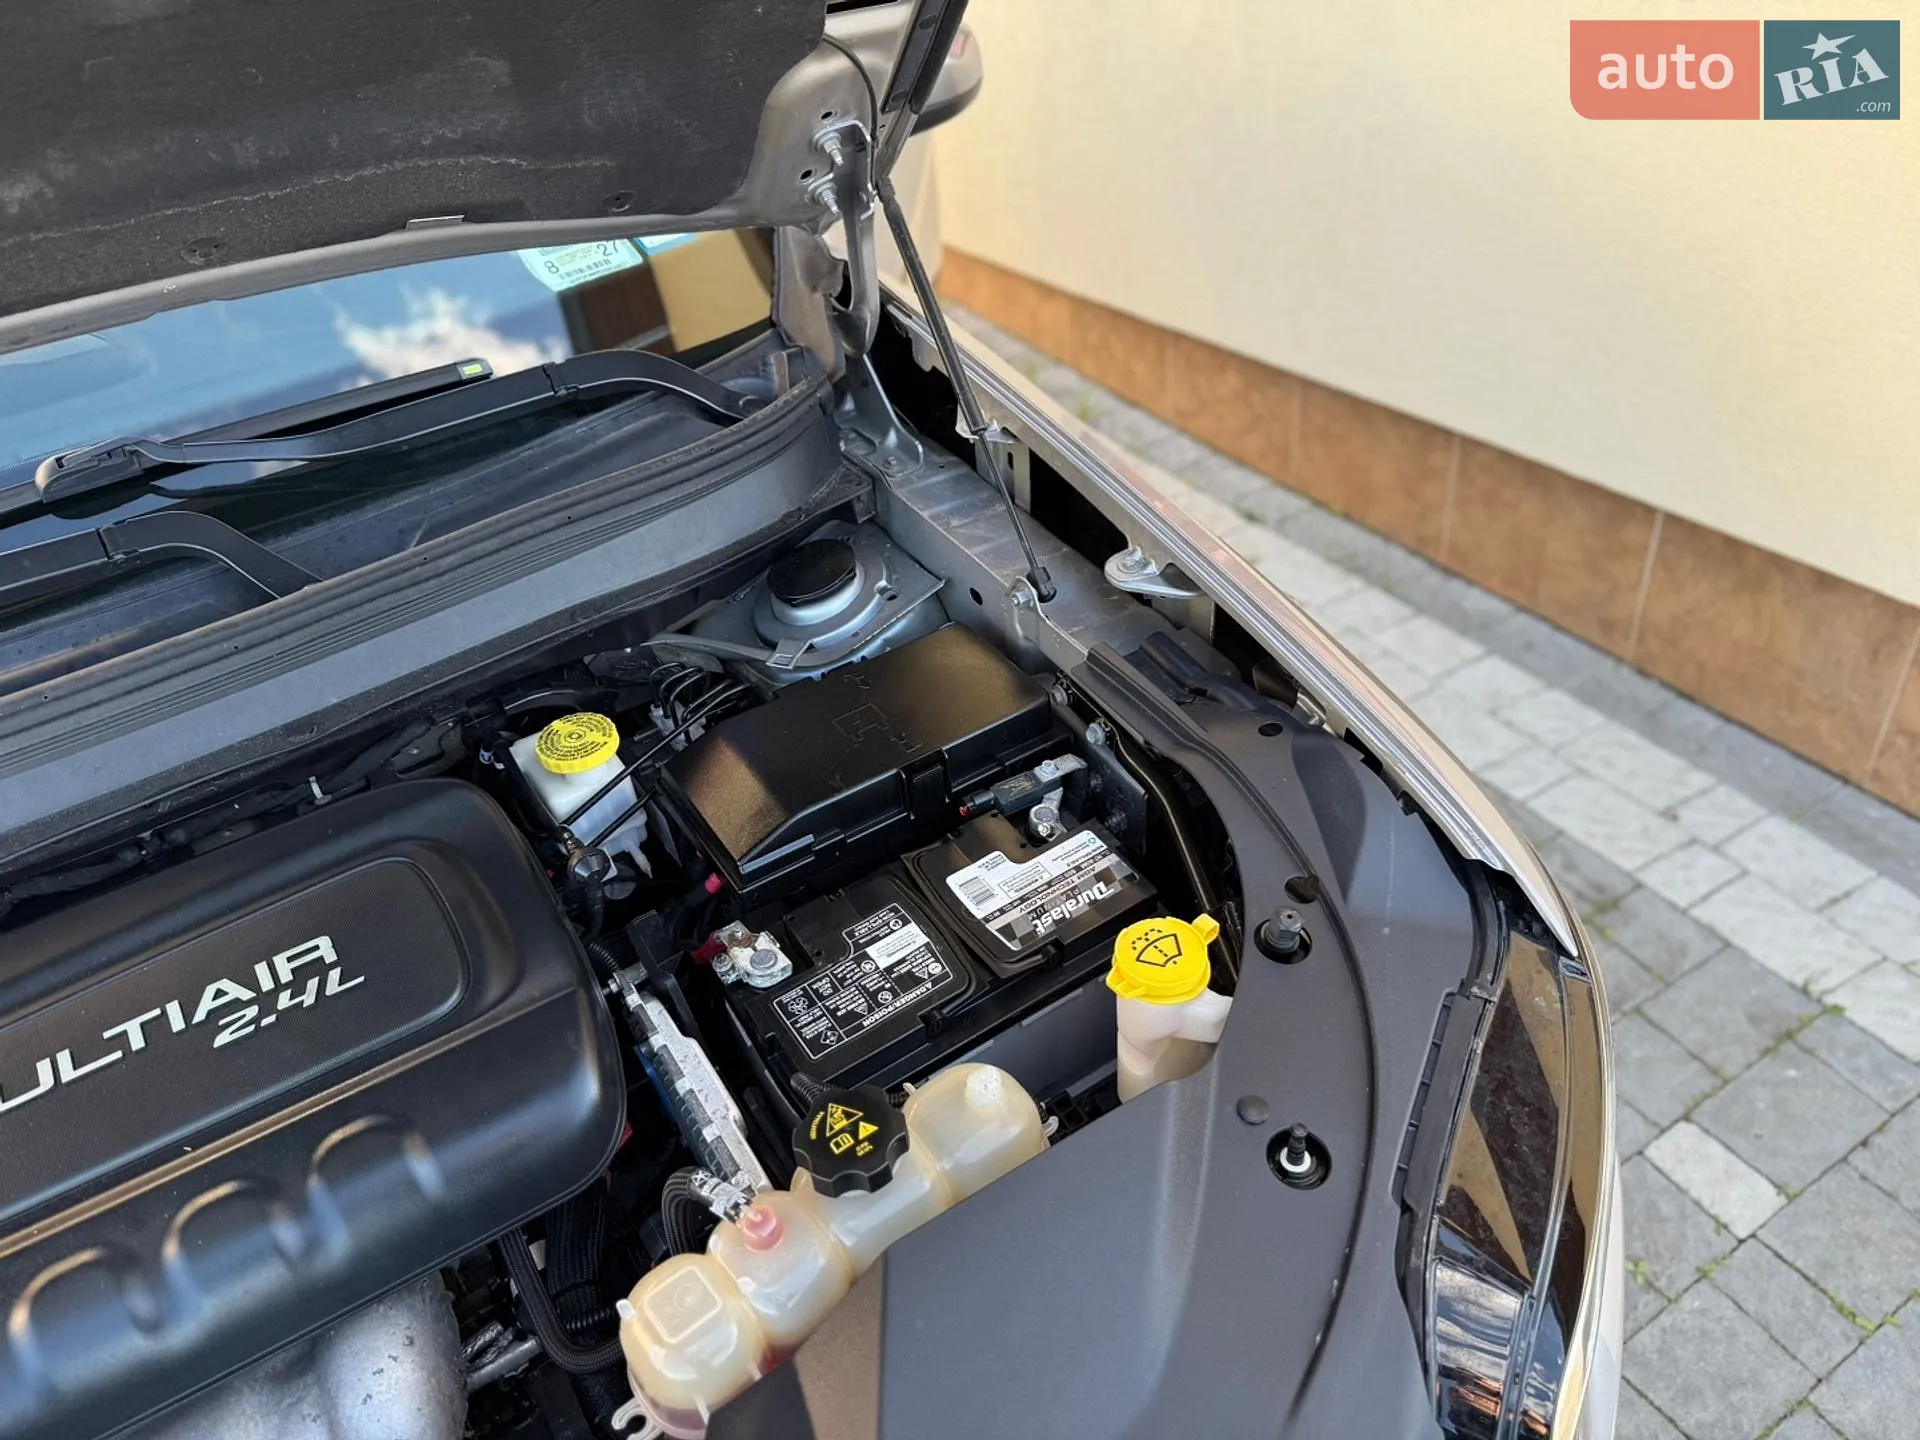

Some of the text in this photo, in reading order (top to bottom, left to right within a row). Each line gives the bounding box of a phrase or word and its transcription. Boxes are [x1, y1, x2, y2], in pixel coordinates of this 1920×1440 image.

[544, 261, 560, 276] 8
[1020, 878, 1074, 912] TECHNOLOGY
[1031, 877, 1114, 935] Duralast
[212, 966, 365, 1048] 2.4L
